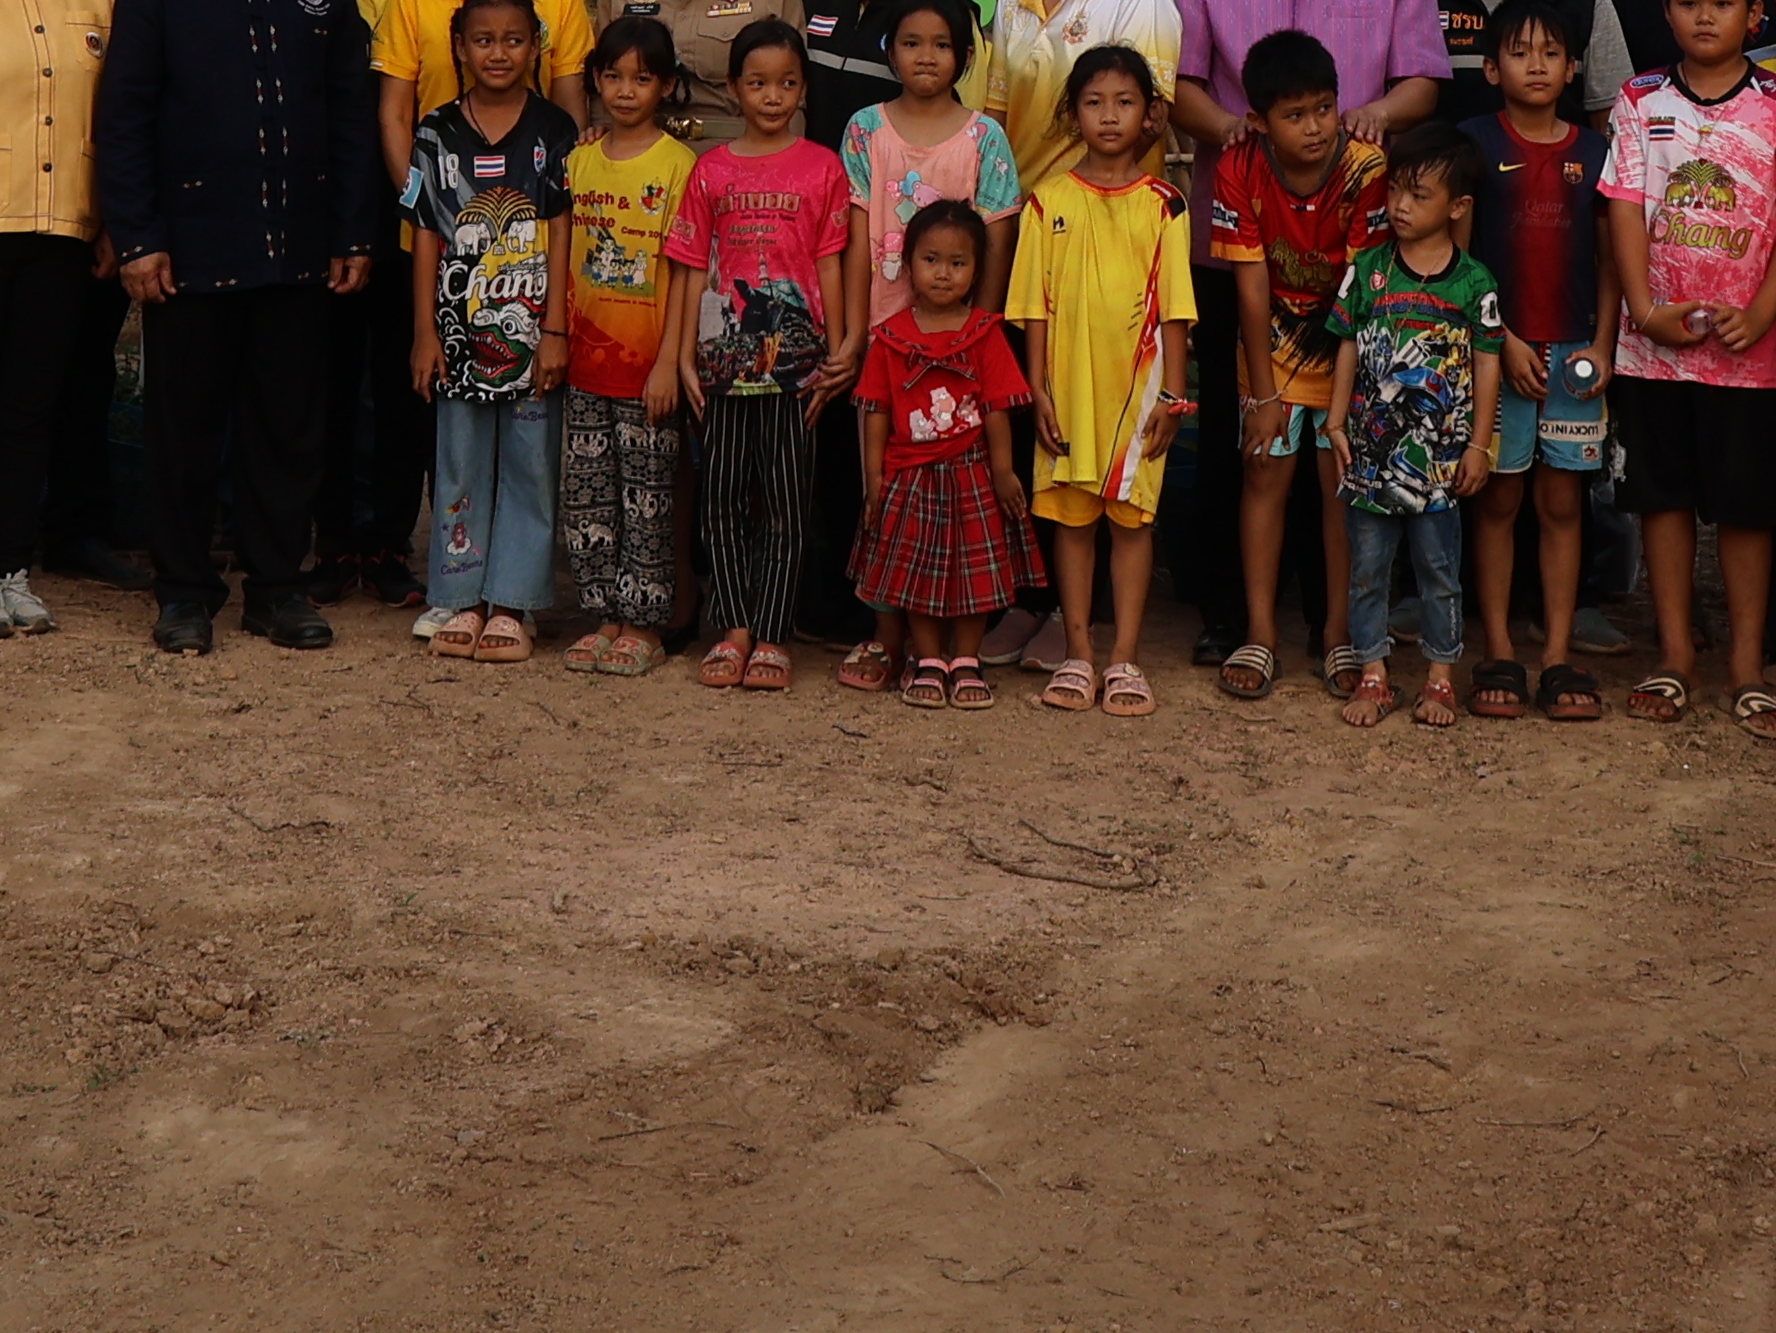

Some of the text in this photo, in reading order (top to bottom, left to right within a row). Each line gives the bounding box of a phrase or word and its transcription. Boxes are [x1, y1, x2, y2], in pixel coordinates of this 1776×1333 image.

[437, 153, 459, 190] 18
[573, 190, 630, 210] nglish &
[573, 213, 616, 228] hinese
[1649, 207, 1753, 259] Chang
[442, 263, 548, 305] Chang
